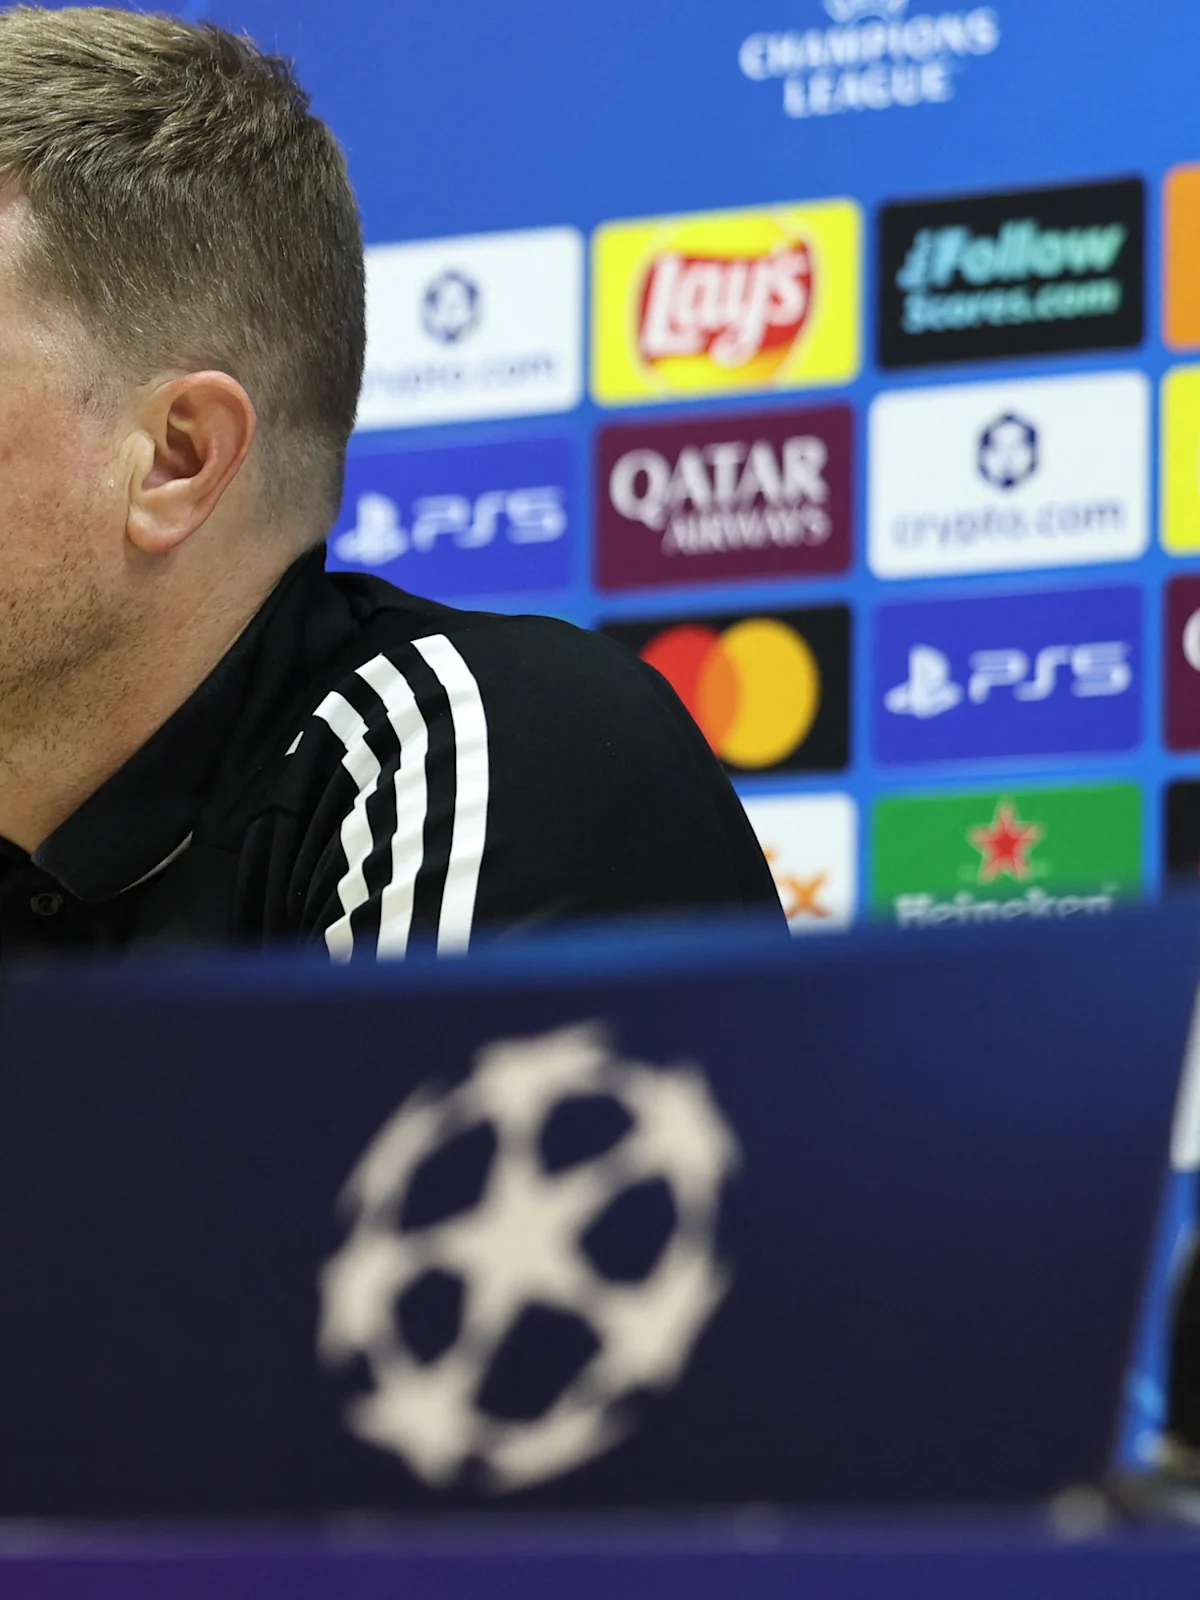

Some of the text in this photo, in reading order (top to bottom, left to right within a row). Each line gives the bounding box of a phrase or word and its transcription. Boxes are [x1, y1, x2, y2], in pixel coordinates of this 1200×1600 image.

[738, 5, 1000, 80] CHAMPIONS
[783, 60, 954, 118] LEAGUE
[640, 238, 810, 366] Lay's
[610, 435, 828, 530] QATAR
[411, 486, 567, 553] PS5
[662, 507, 832, 556] AIRWAYS
[890, 498, 1125, 550] crypto.com
[968, 640, 1133, 704] PS5
